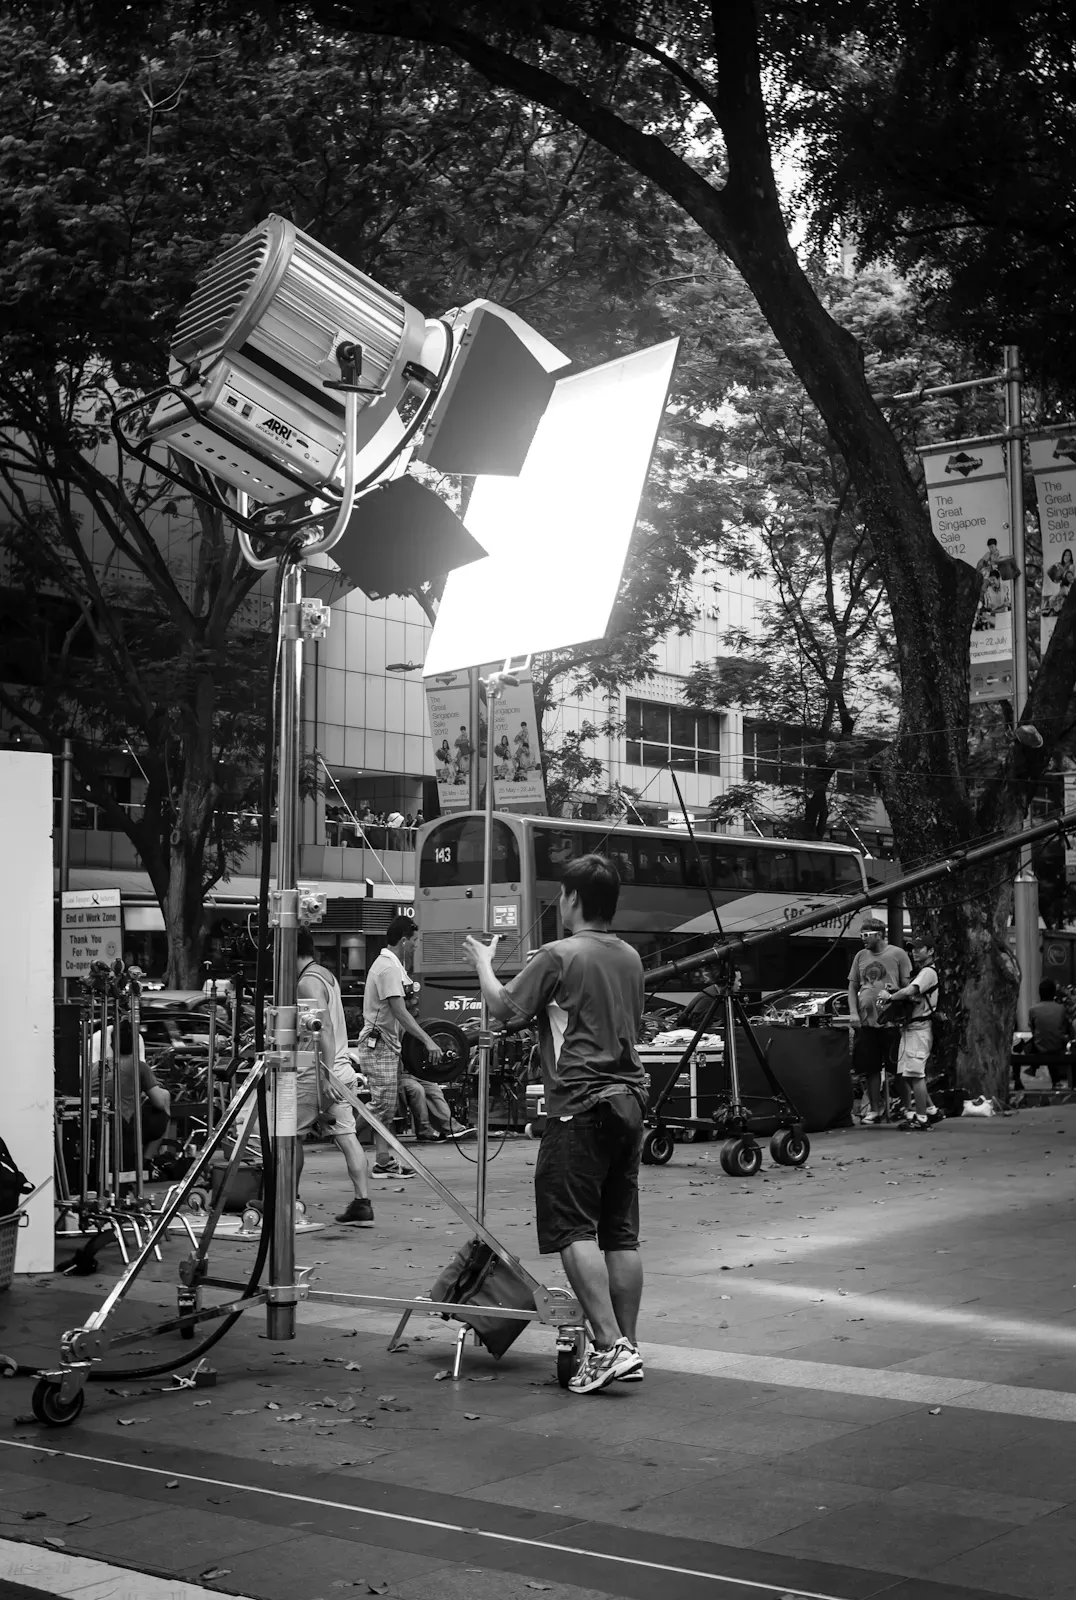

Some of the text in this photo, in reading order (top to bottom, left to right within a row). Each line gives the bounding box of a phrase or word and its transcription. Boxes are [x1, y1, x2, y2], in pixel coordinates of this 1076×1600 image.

[262, 418, 292, 440] ARRI
[1042, 481, 1062, 492] The
[935, 496, 953, 506] The
[1044, 493, 1072, 505] Great
[937, 507, 963, 519] Great
[1046, 507, 1076, 518] Singa
[938, 516, 987, 532] Singapore
[1047, 519, 1070, 531] Sale
[940, 533, 961, 544] Sale
[1049, 530, 1075, 544] 2012
[985, 636, 994, 646] 22
[432, 711, 459, 720] Singapore
[494, 708, 520, 716] ingapore
[433, 720, 445, 728] Sale
[435, 728, 449, 736] 2012
[435, 847, 451, 863] 143
[66, 912, 117, 923] End of Work Zone
[69, 934, 102, 944] Thank You
[72, 947, 98, 957] For Your
[65, 960, 90, 971] Co-oper
[444, 997, 482, 1011] SBS Tran
